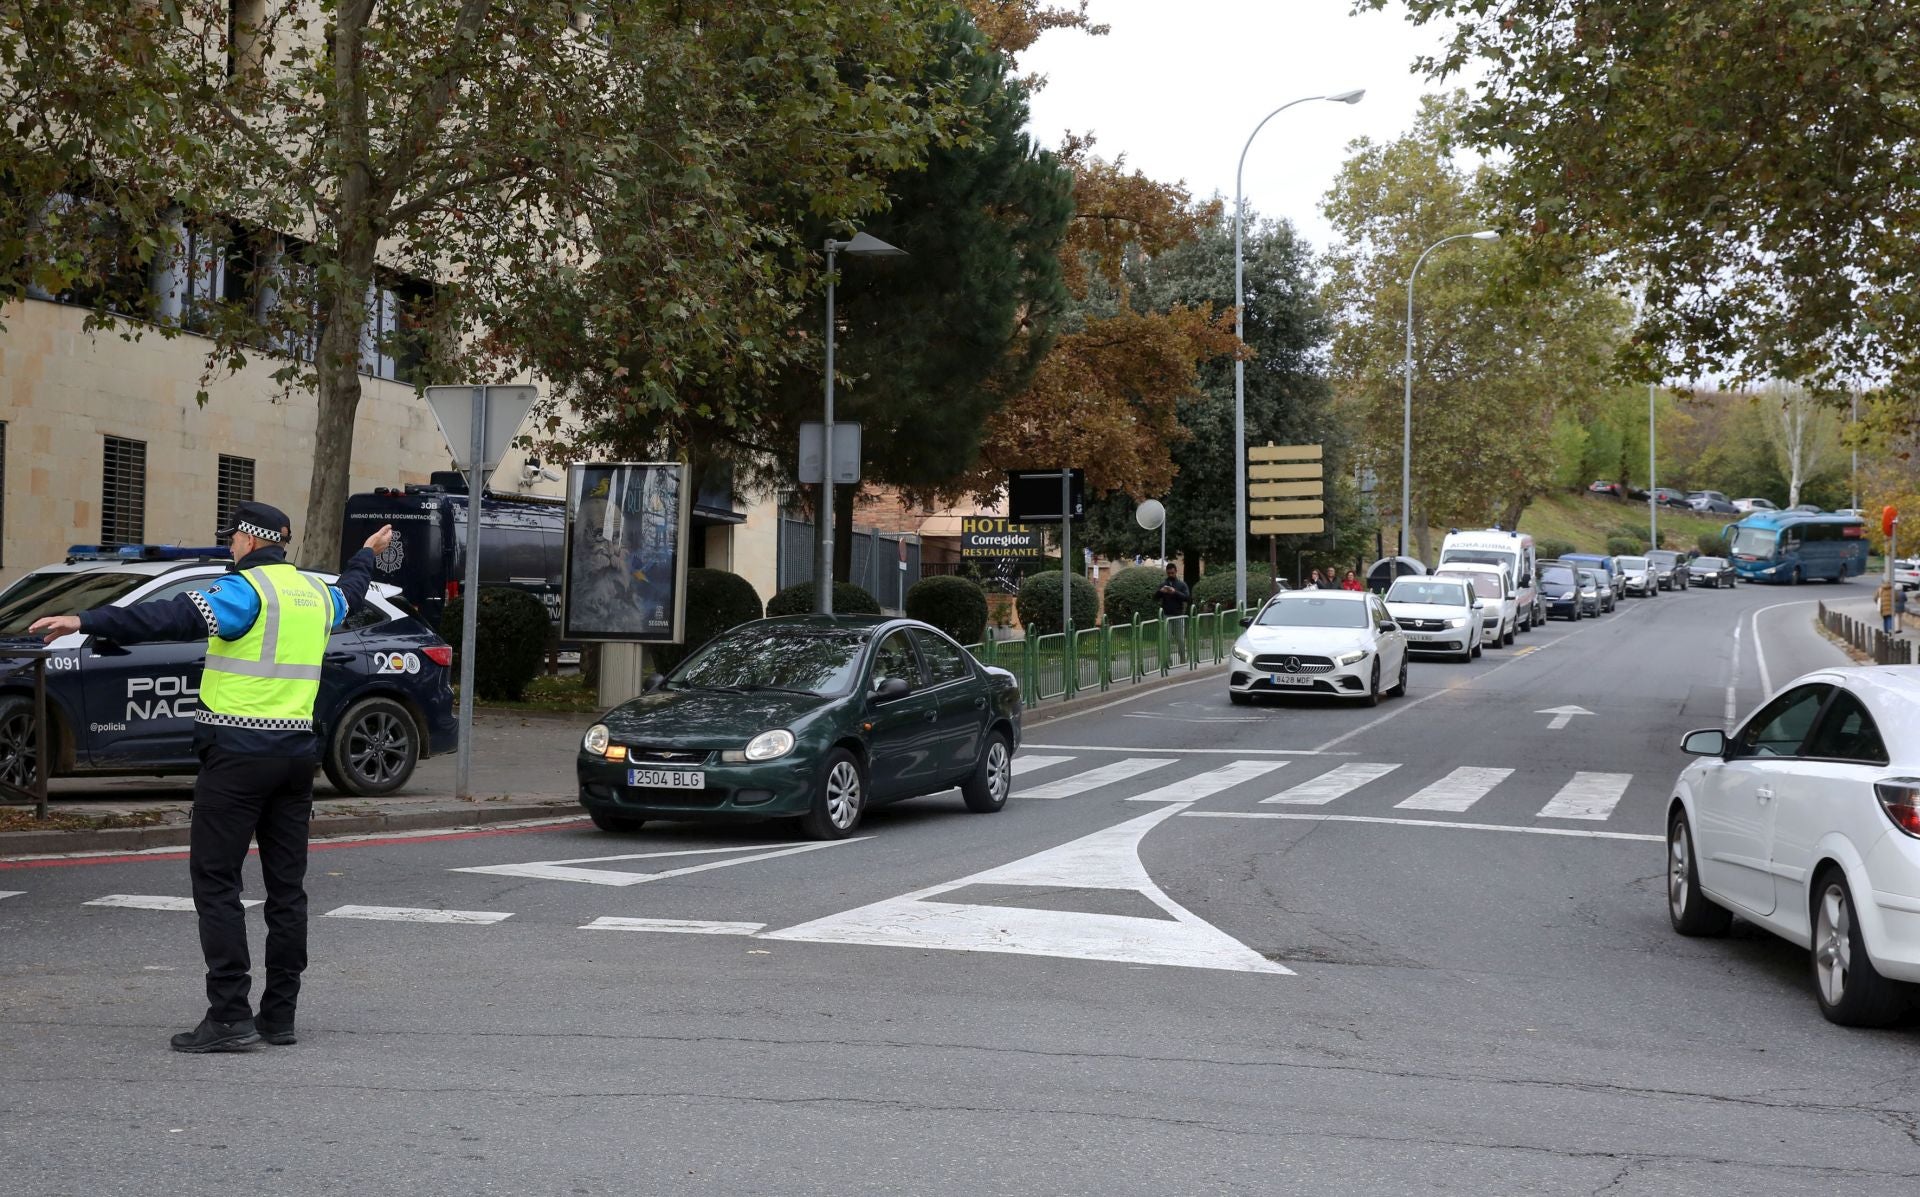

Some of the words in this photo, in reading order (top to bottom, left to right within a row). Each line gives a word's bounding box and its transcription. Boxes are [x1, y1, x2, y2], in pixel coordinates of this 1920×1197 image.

[963, 519, 1029, 533] HOTEL
[971, 534, 1030, 547] Corregidor
[963, 548, 1039, 556] RESTAURANTE
[294, 598, 317, 607] SEGOVIA
[55, 657, 80, 670] 091
[374, 652, 420, 674] 200
[90, 722, 126, 733] @policia
[637, 771, 668, 785] 2504
[673, 772, 699, 787] BLG
